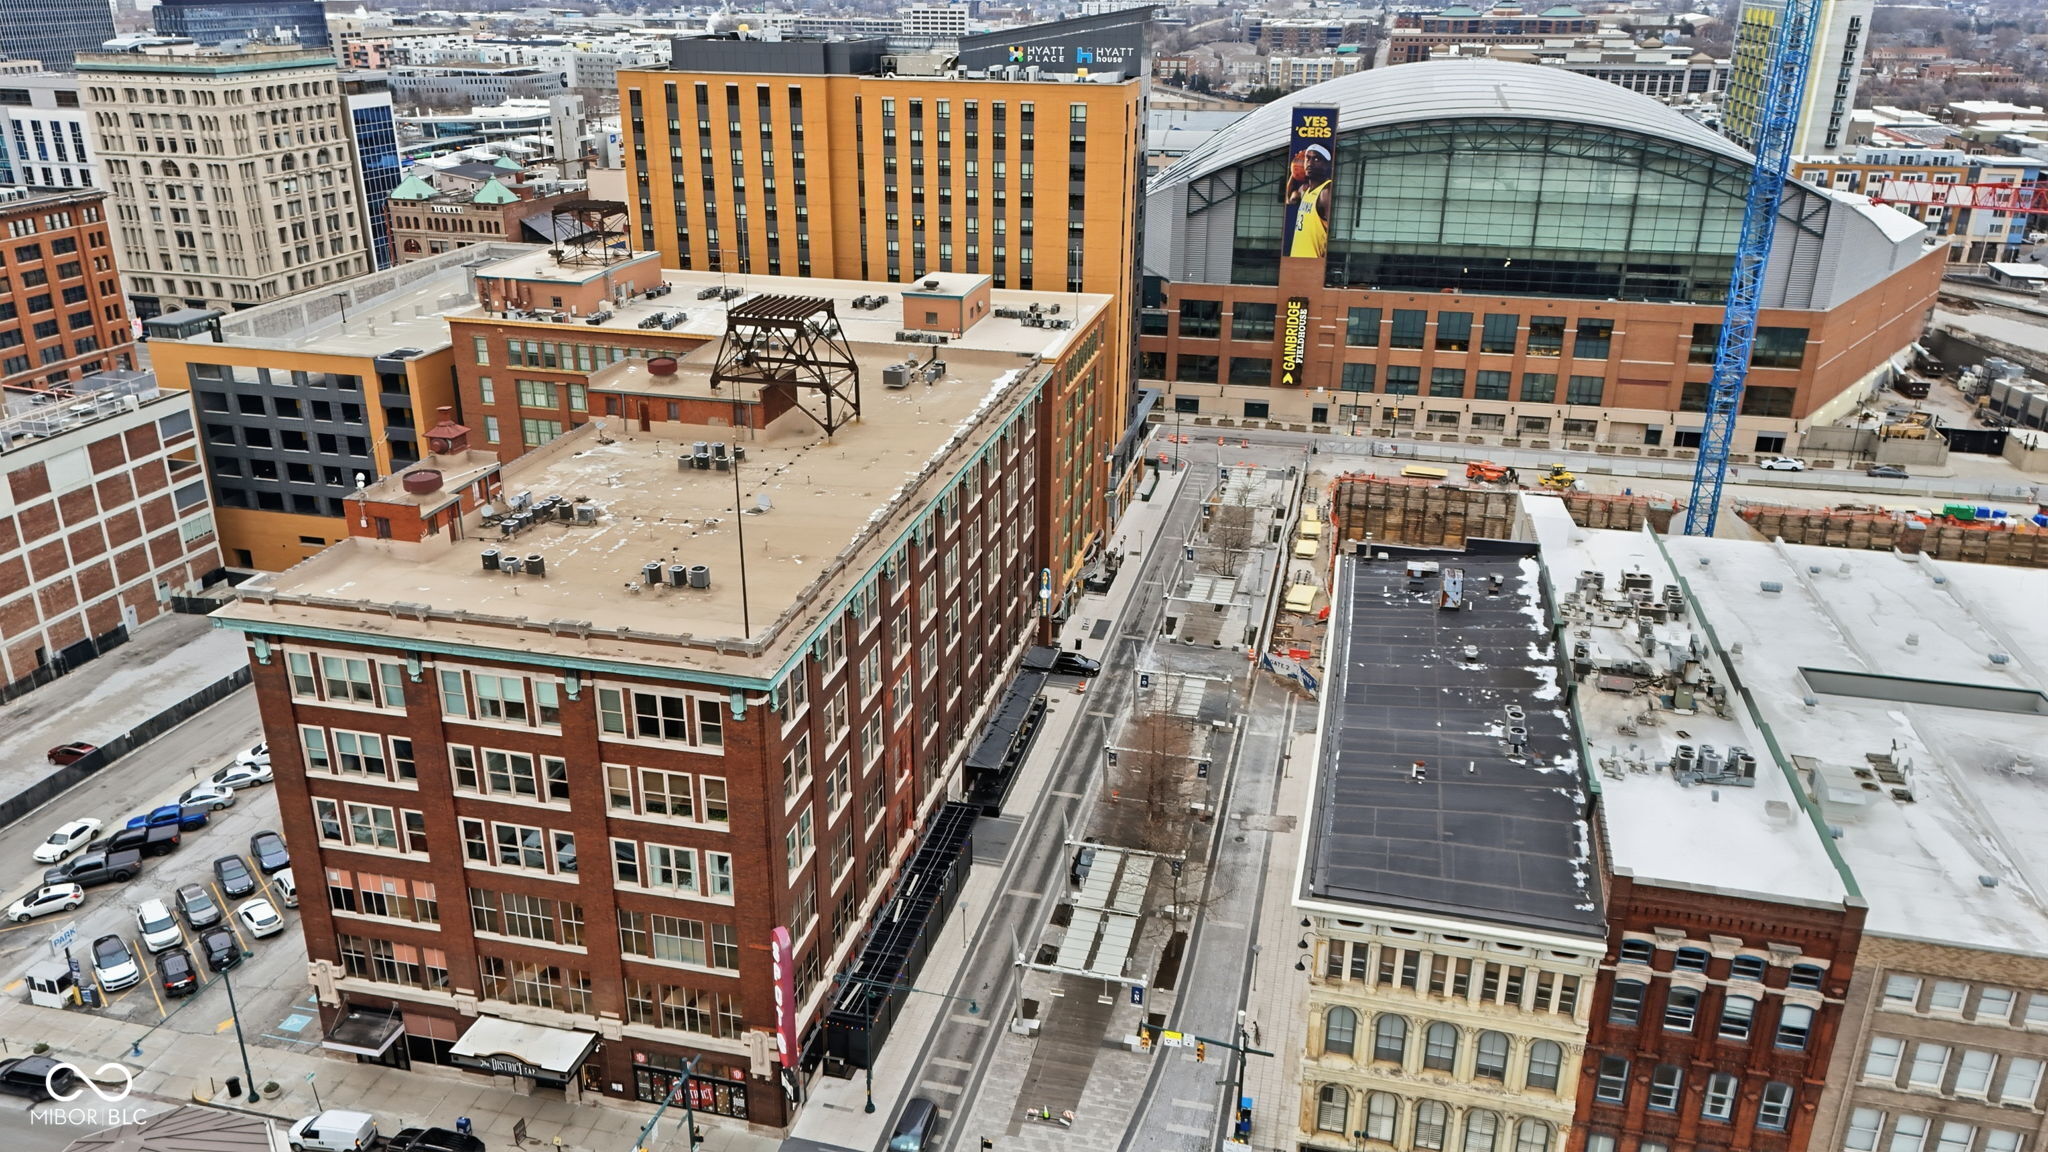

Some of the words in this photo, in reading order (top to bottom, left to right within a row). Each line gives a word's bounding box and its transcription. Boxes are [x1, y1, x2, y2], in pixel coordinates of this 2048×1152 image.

[1027, 46, 1065, 56] HYATT
[1096, 47, 1134, 57] HYATT
[1303, 116, 1328, 127] YES
[1295, 127, 1332, 138] 'CERS
[1283, 301, 1301, 371] GAINBRIDGE
[1295, 308, 1308, 364] FIELDHOUSE
[53, 926, 77, 947] PARK
[491, 1058, 523, 1076] DISTRICT
